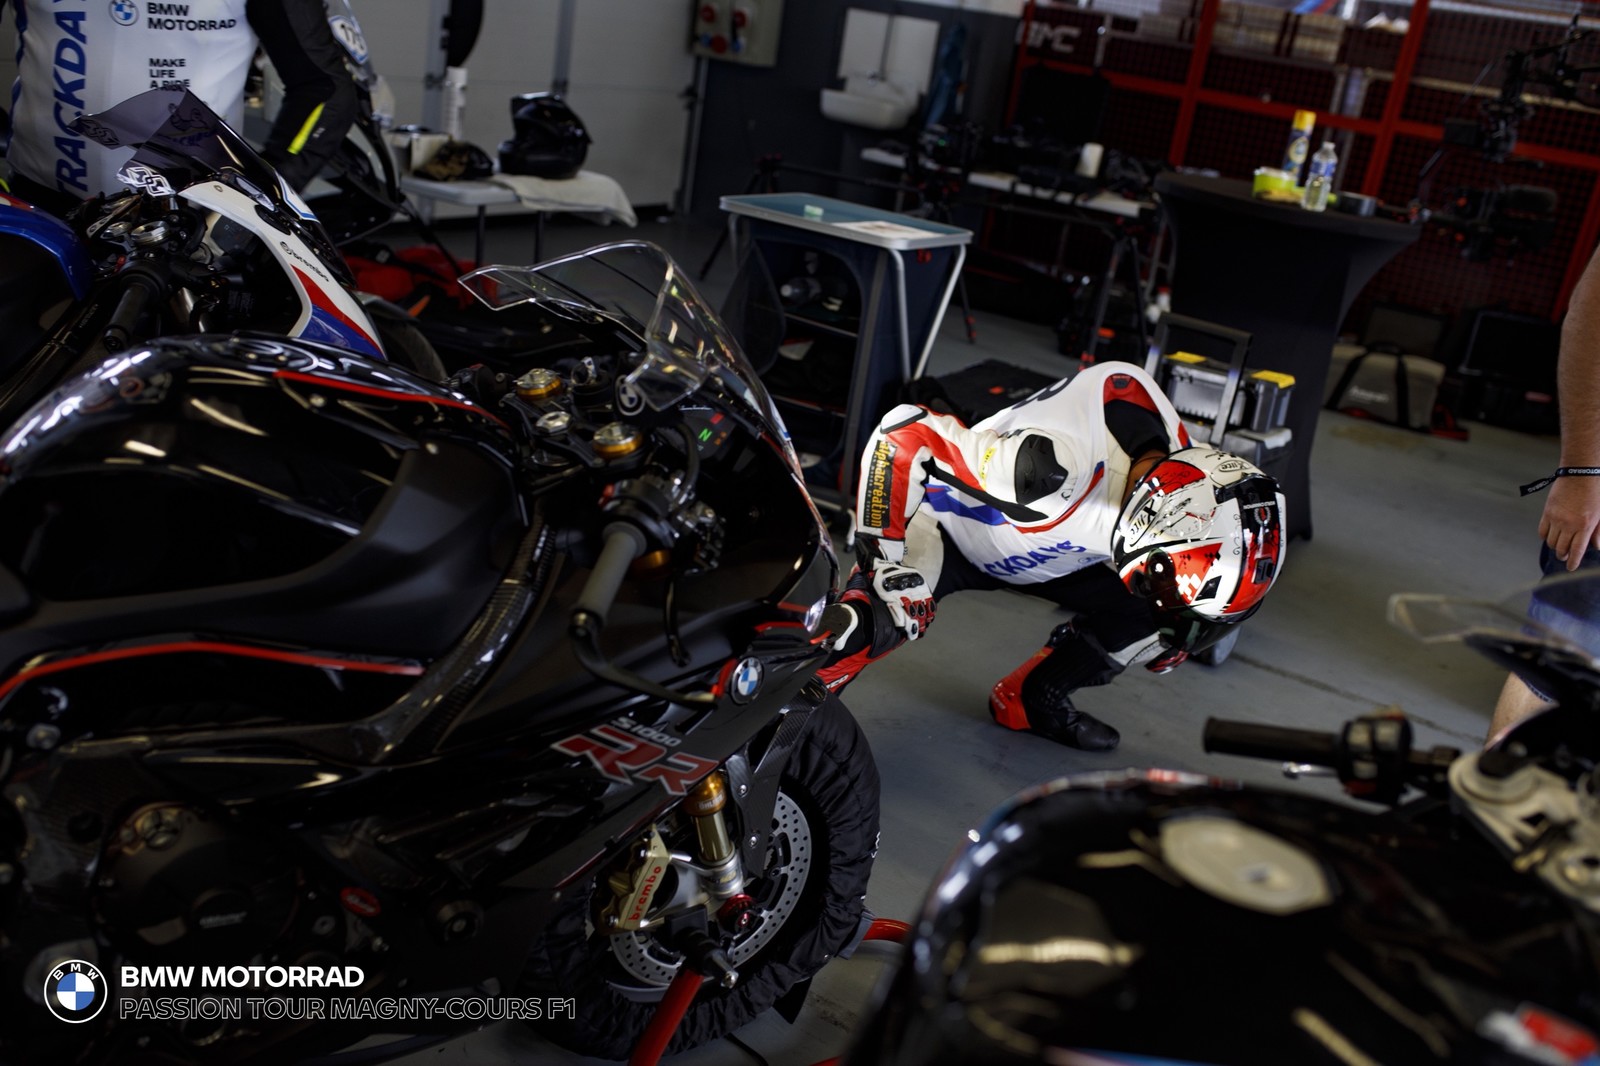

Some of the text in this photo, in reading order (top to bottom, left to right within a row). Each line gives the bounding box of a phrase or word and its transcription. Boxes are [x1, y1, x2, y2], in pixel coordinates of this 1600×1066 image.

[147, 2, 190, 16] BMW
[147, 18, 237, 31] MOTORRAD
[149, 58, 186, 67] MAKE
[149, 69, 176, 78] LIFE
[150, 80, 159, 88] A
[871, 440, 890, 528] alphacréation
[550, 723, 720, 796] RR
[628, 865, 663, 922] brembo
